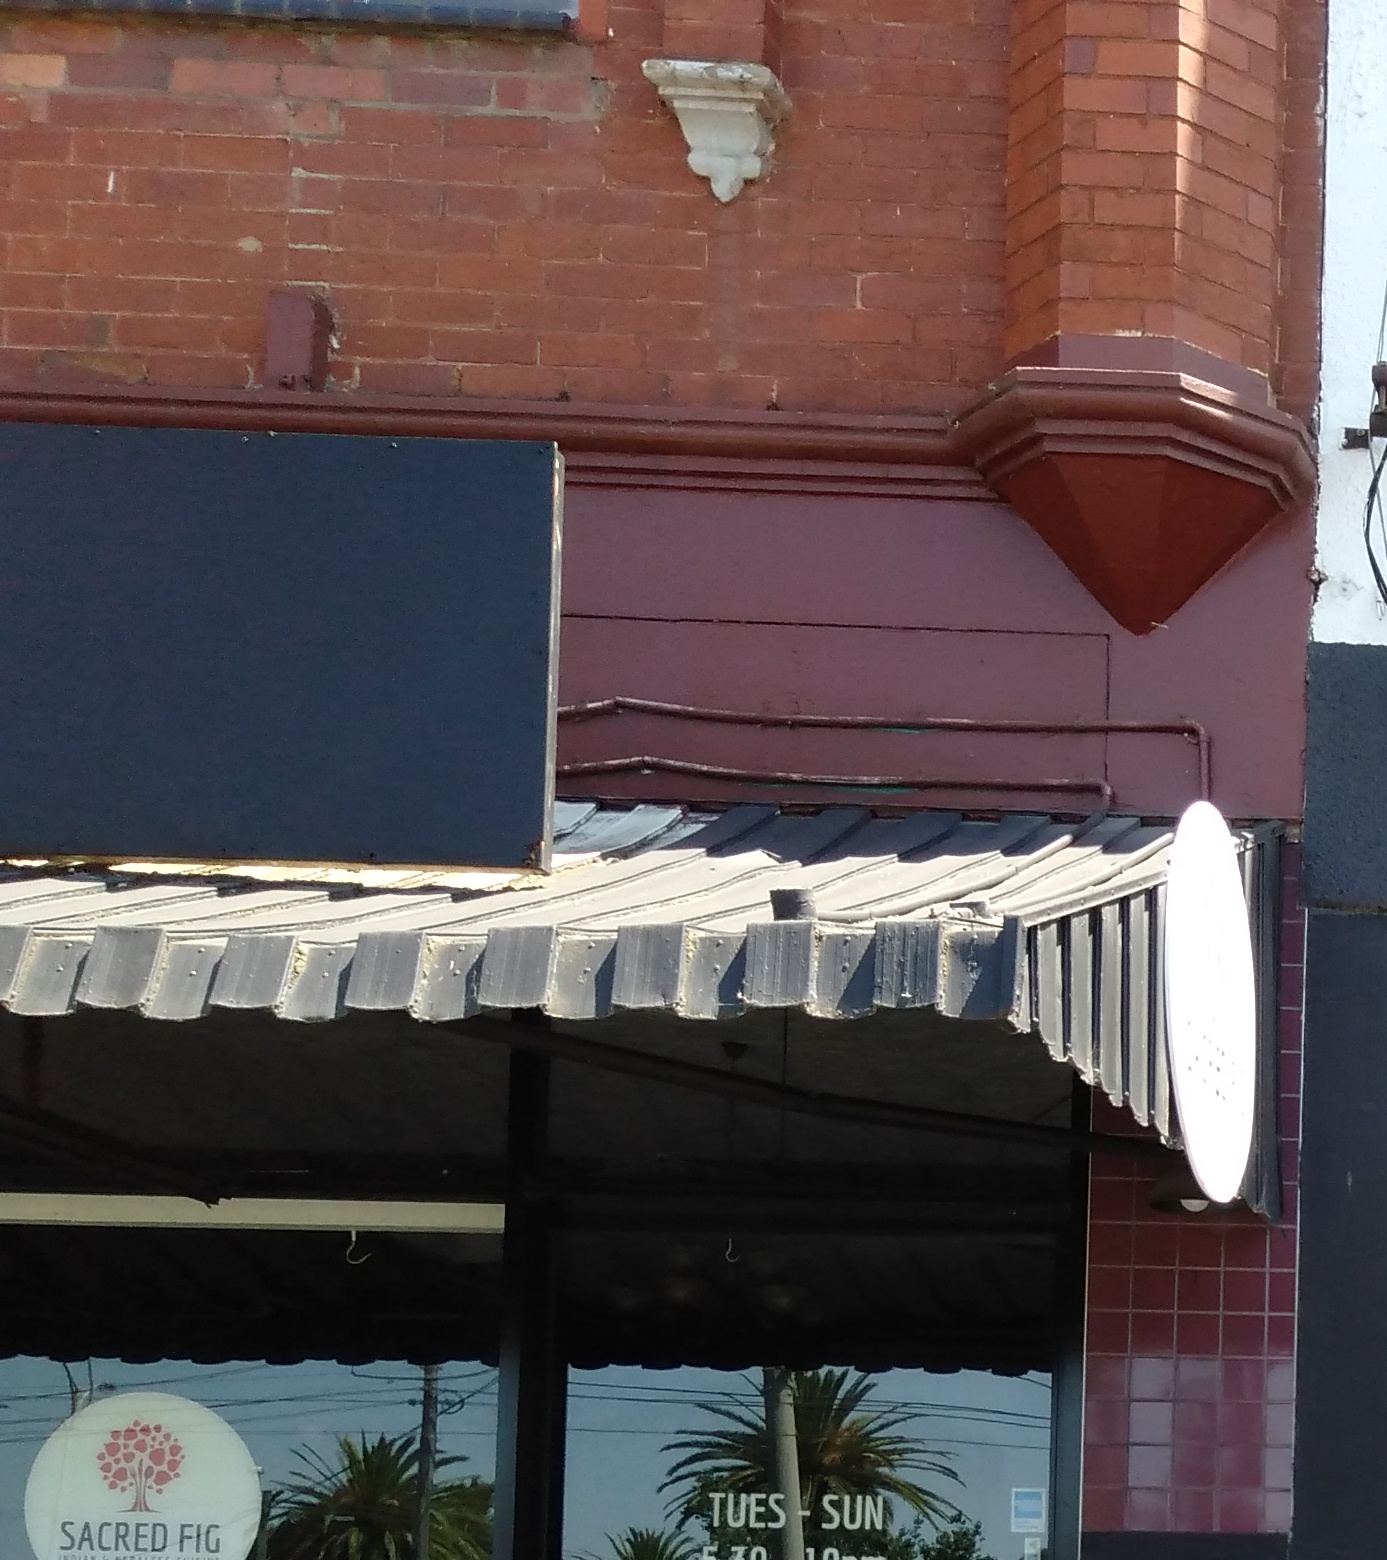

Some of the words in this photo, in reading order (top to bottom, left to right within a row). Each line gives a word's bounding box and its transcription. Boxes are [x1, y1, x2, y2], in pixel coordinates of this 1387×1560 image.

[708, 1492, 787, 1529] TUES
[797, 1510, 811, 1518] -
[821, 1494, 884, 1530] SUN
[59, 1521, 168, 1552] SACRED
[179, 1523, 221, 1554] FIG
